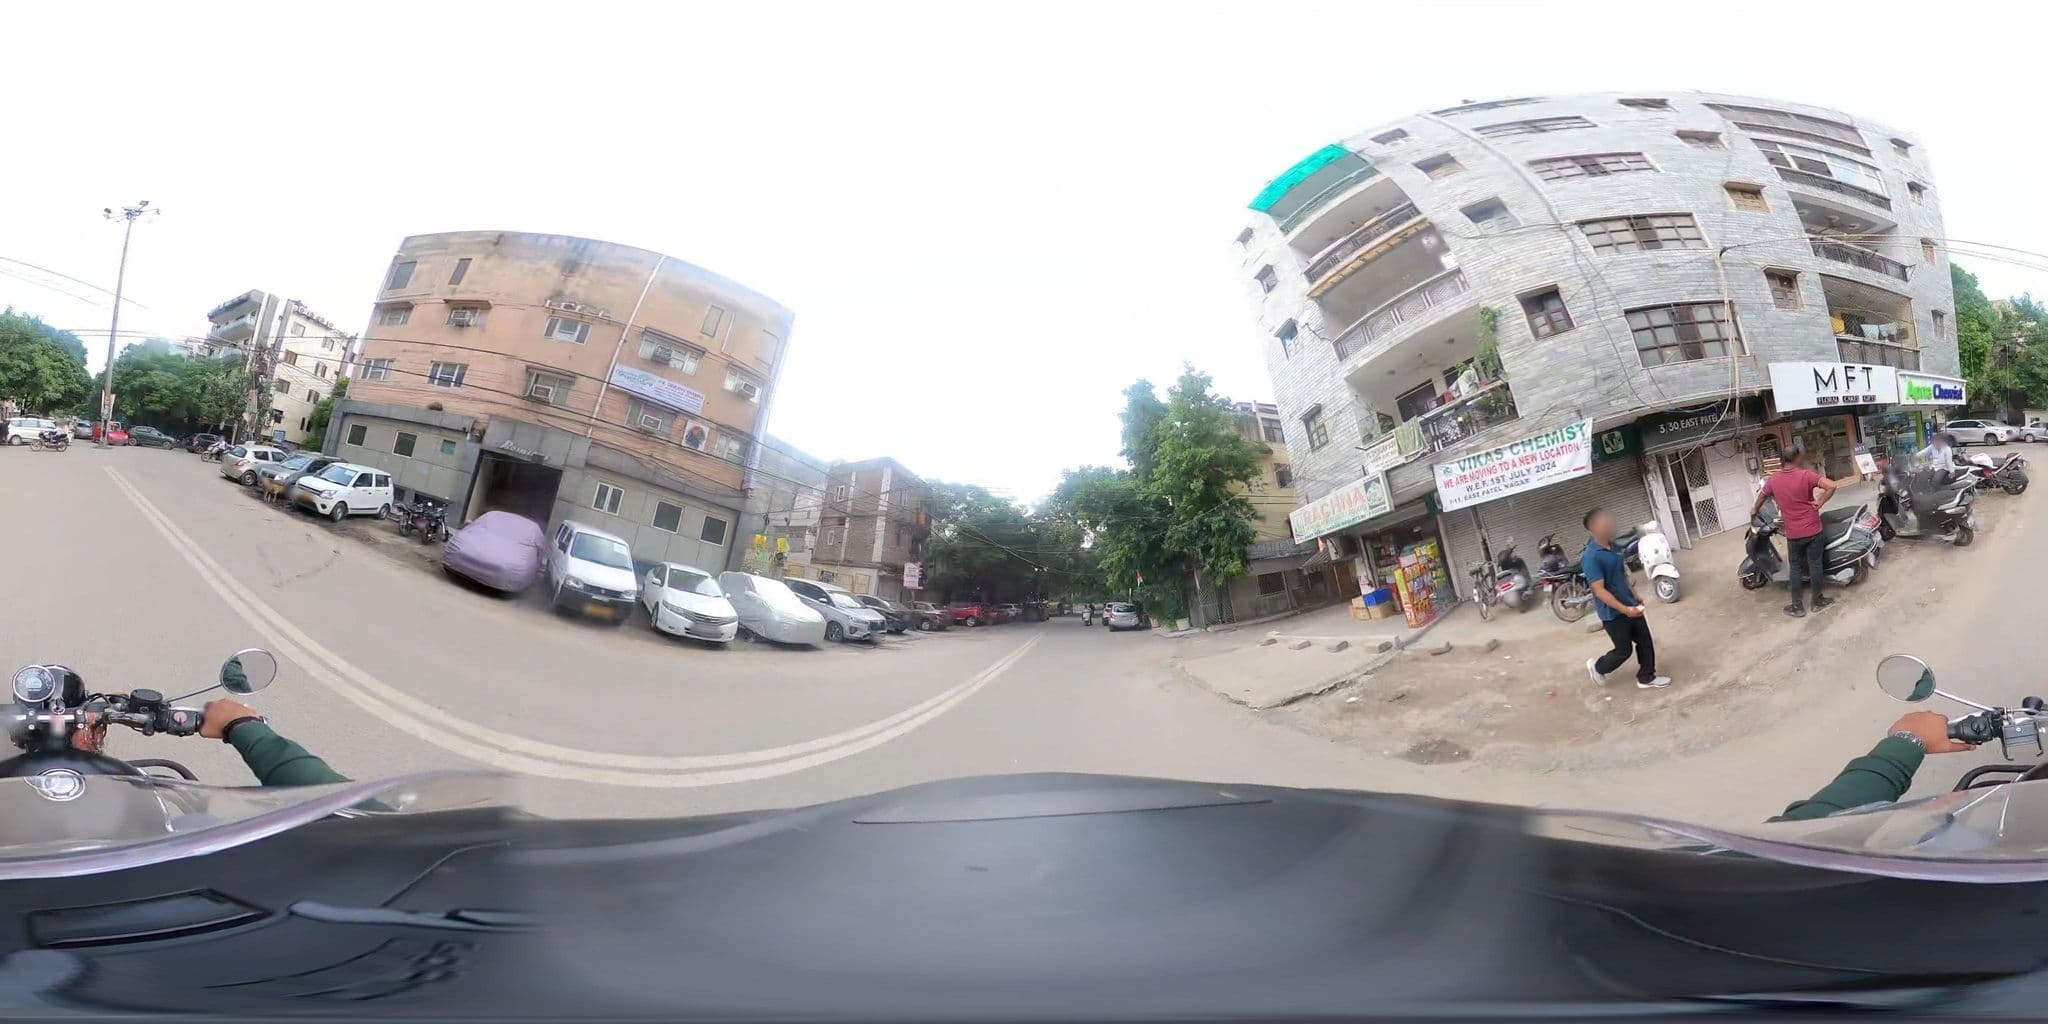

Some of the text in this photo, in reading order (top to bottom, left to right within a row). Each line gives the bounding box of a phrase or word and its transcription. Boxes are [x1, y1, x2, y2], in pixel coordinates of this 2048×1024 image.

[1812, 366, 1873, 392] MFT
[1457, 448, 1504, 472] VIKAS
[1510, 422, 1586, 455] CHEMIST
[1443, 442, 1580, 489] WE ARE MOVING TO A NEW LOCATION
[1490, 475, 1506, 485] 1ST
[1508, 468, 1532, 481] JULY
[1535, 461, 1557, 473] 2024
[1464, 490, 1480, 501] EAST
[1481, 486, 1502, 497] PATEL
